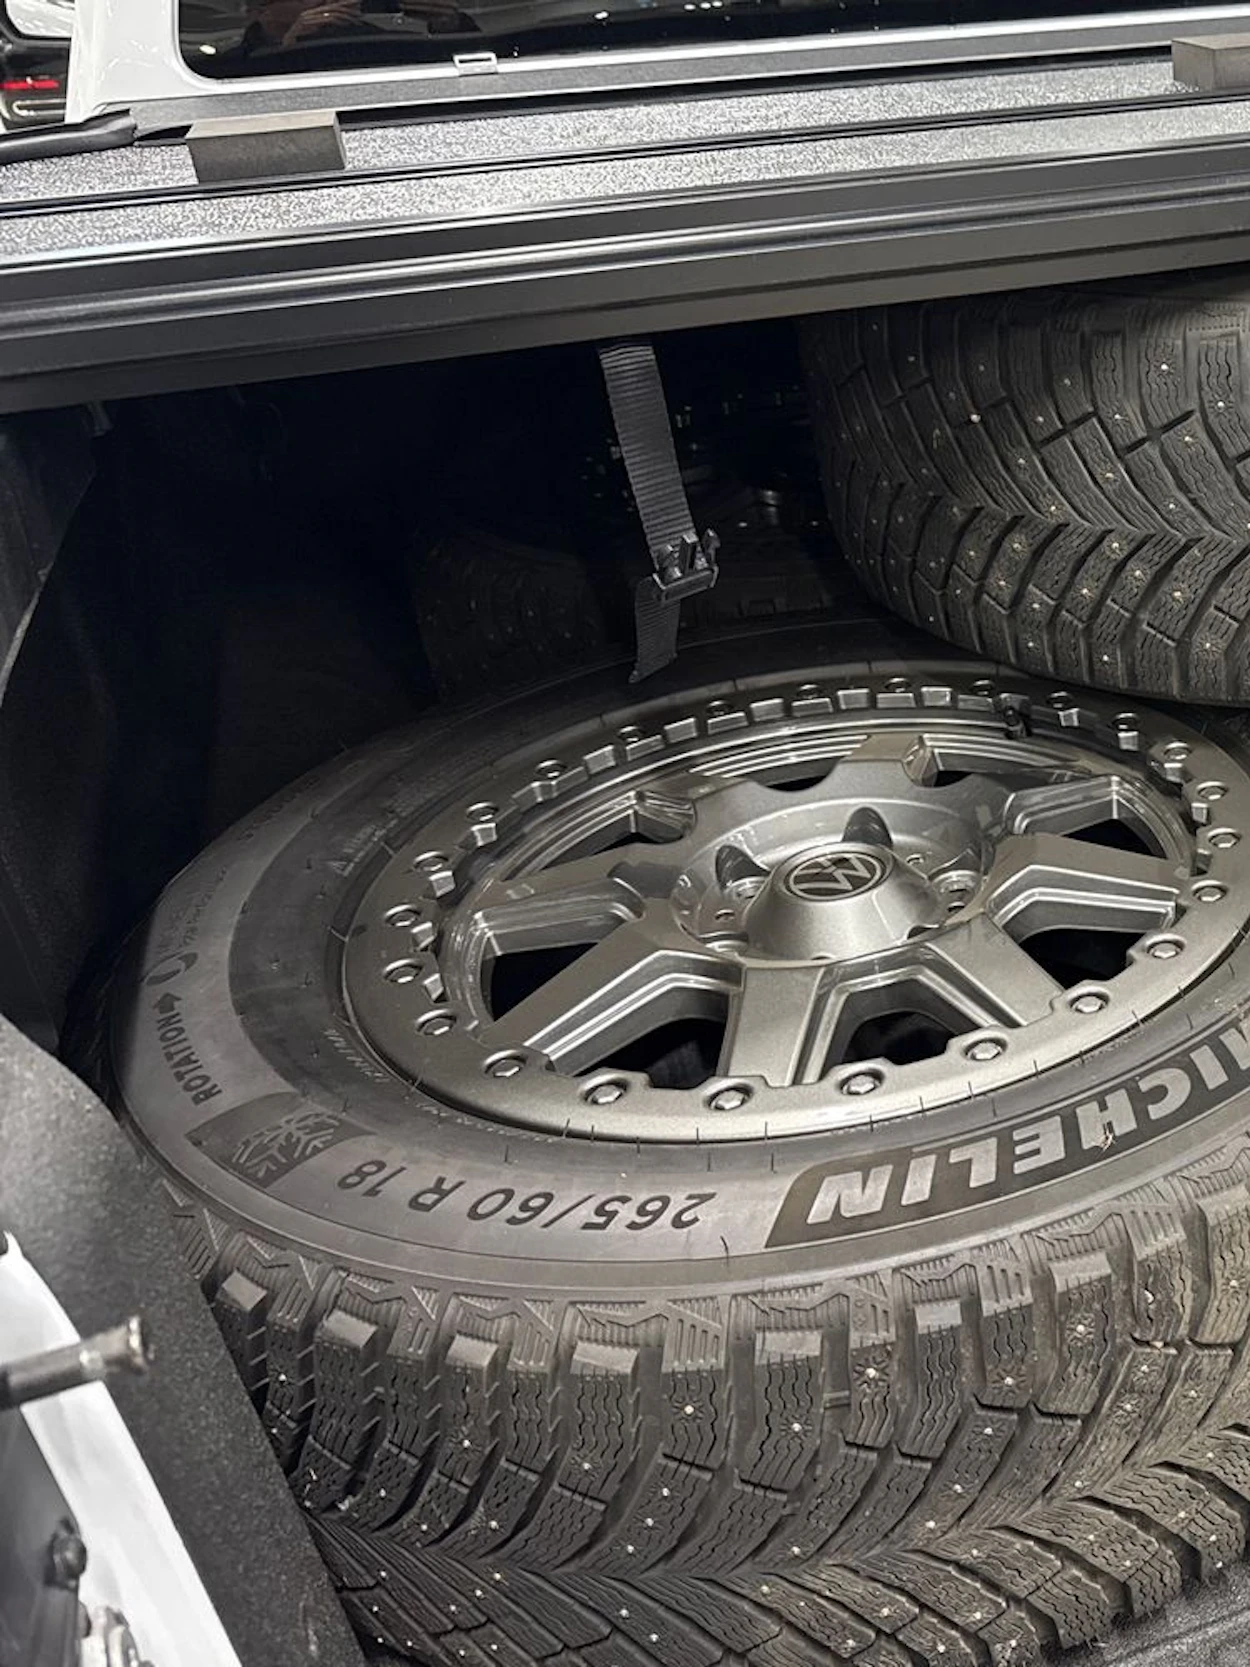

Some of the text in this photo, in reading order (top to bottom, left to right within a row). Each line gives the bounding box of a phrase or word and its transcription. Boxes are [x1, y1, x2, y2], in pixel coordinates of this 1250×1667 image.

[157, 1012, 221, 1105] ROTATION
[337, 1158, 717, 1231] 265/60 R 18
